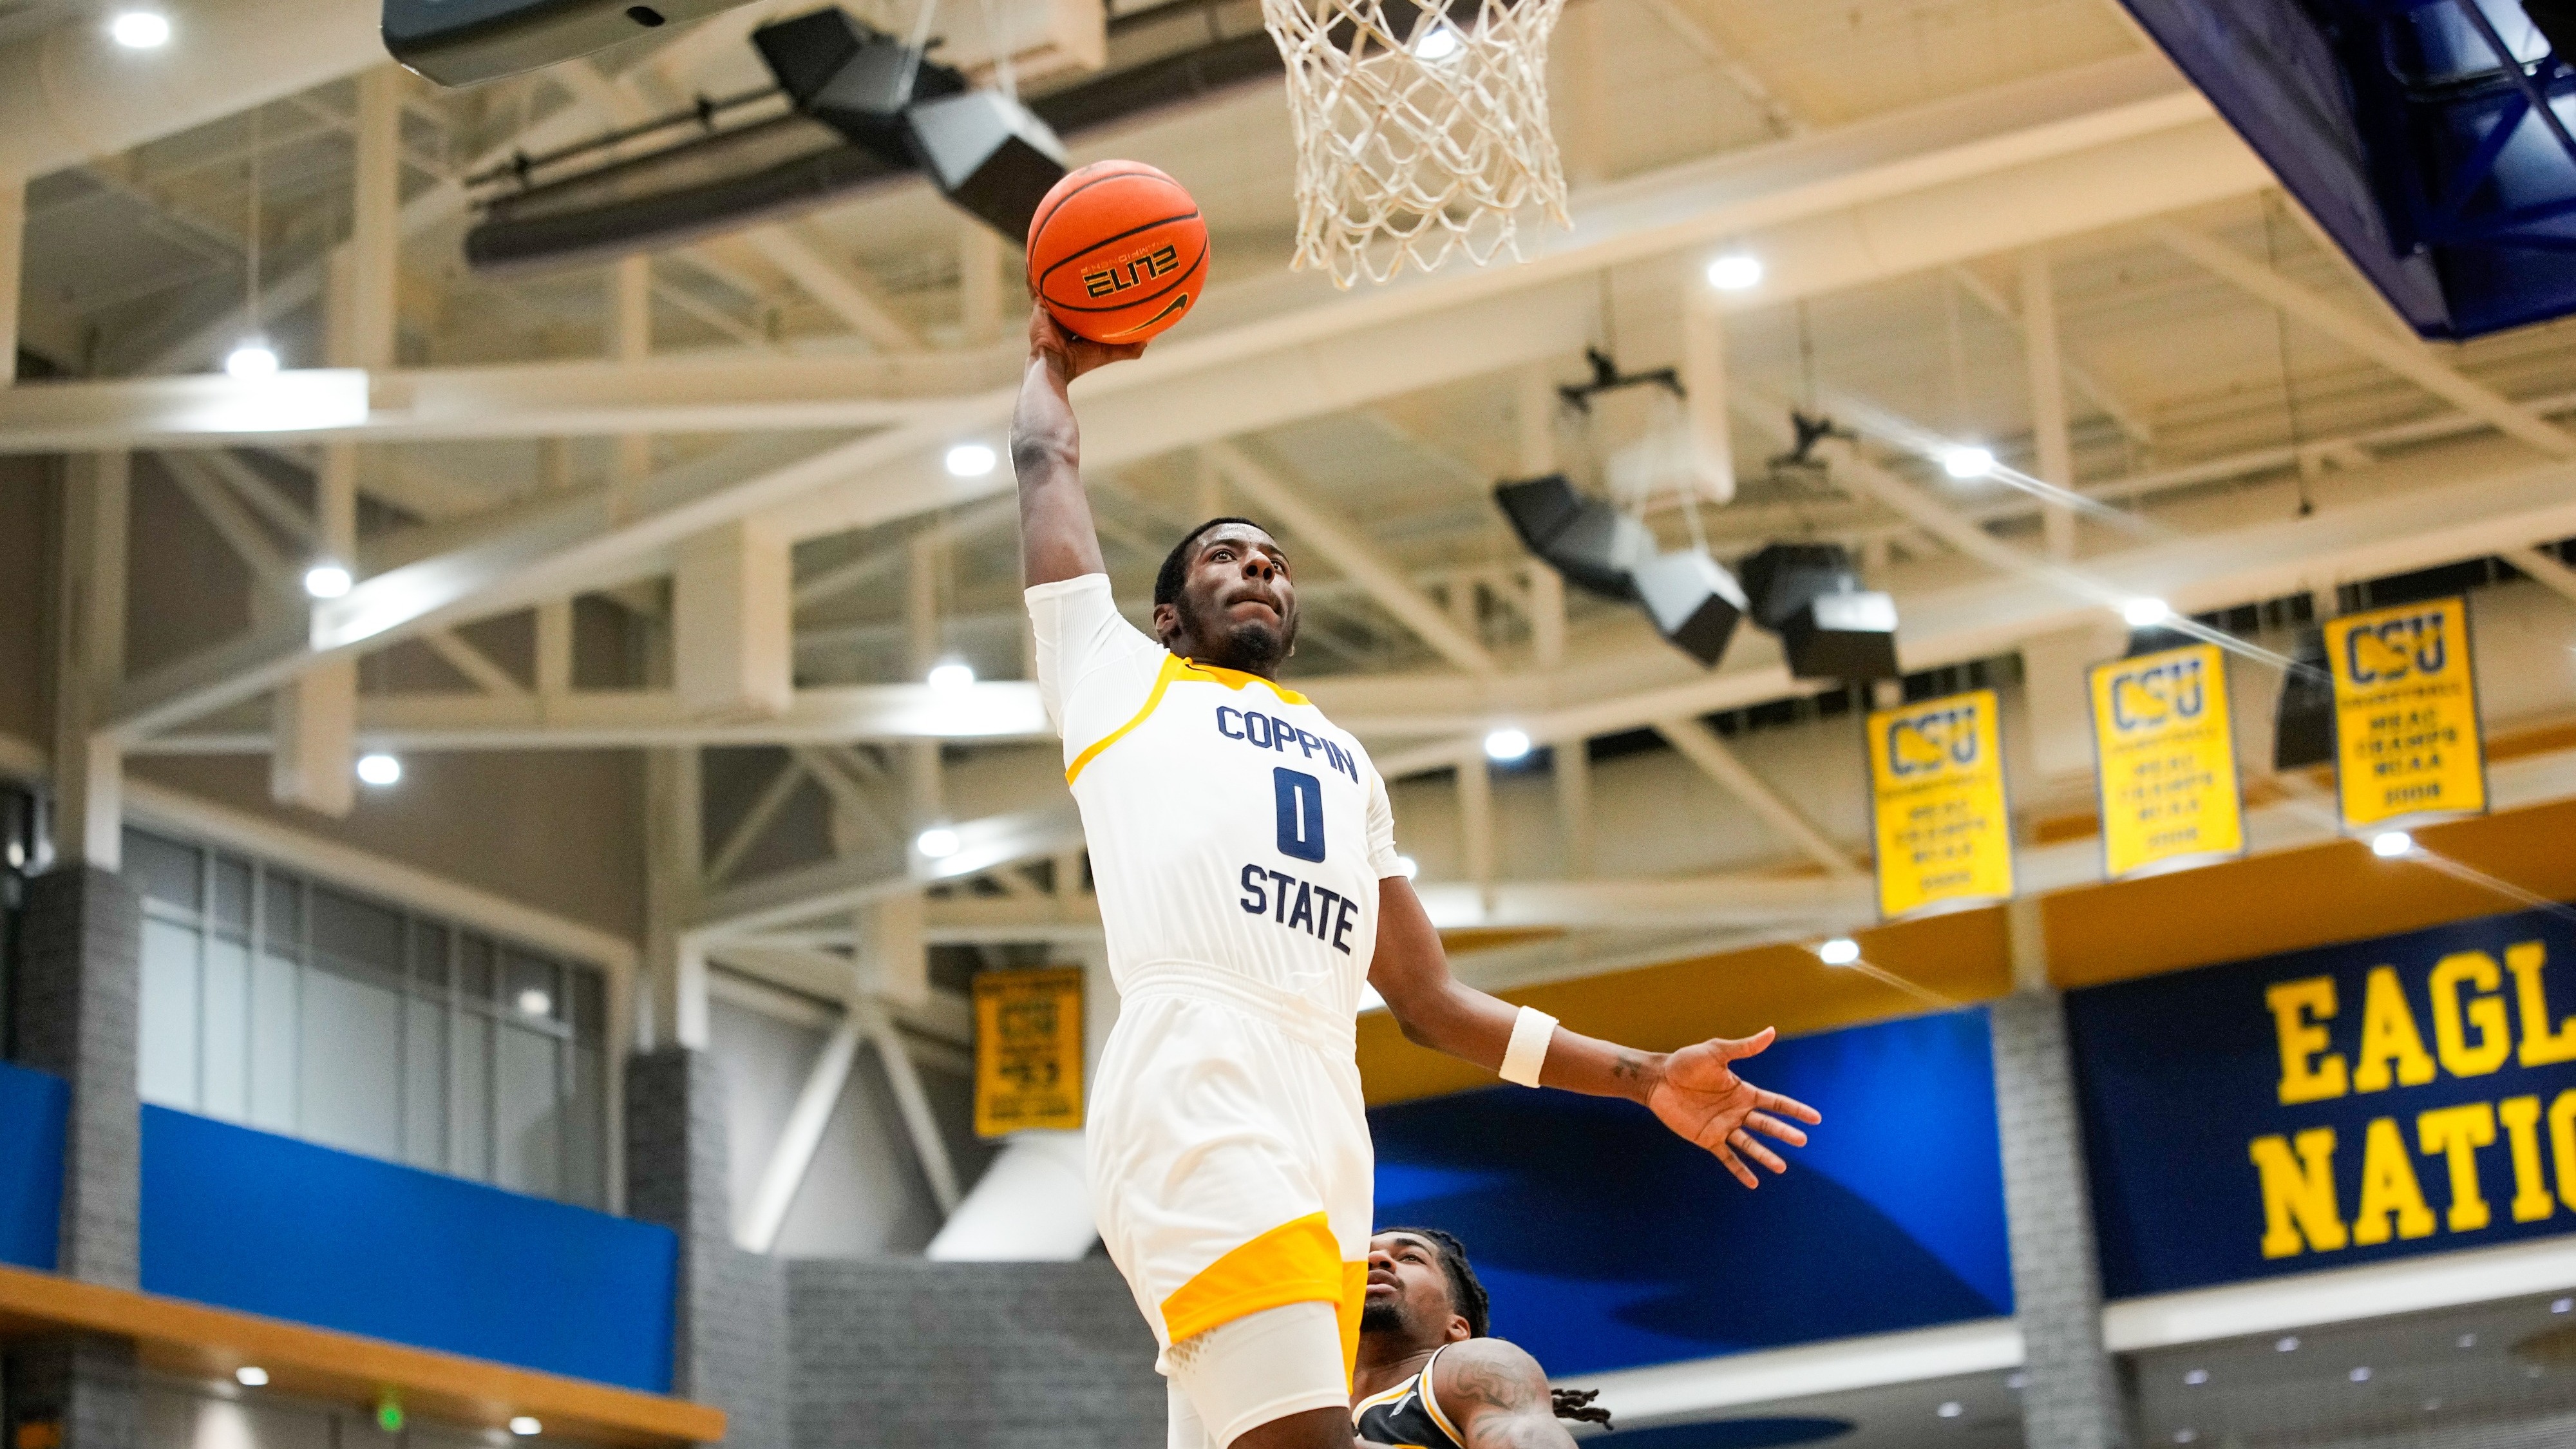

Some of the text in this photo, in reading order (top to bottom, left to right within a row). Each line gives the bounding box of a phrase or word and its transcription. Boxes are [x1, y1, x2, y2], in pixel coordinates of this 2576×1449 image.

[1083, 243, 1180, 299] ELITE
[2346, 612, 2445, 684] CSU
[2112, 659, 2202, 730] CSU
[1217, 706, 1358, 784] COPPIN
[1888, 706, 1977, 777] CSU
[1273, 767, 1325, 863] 0
[1241, 864, 1358, 956] STATE
[2265, 940, 2576, 1106] EAGL
